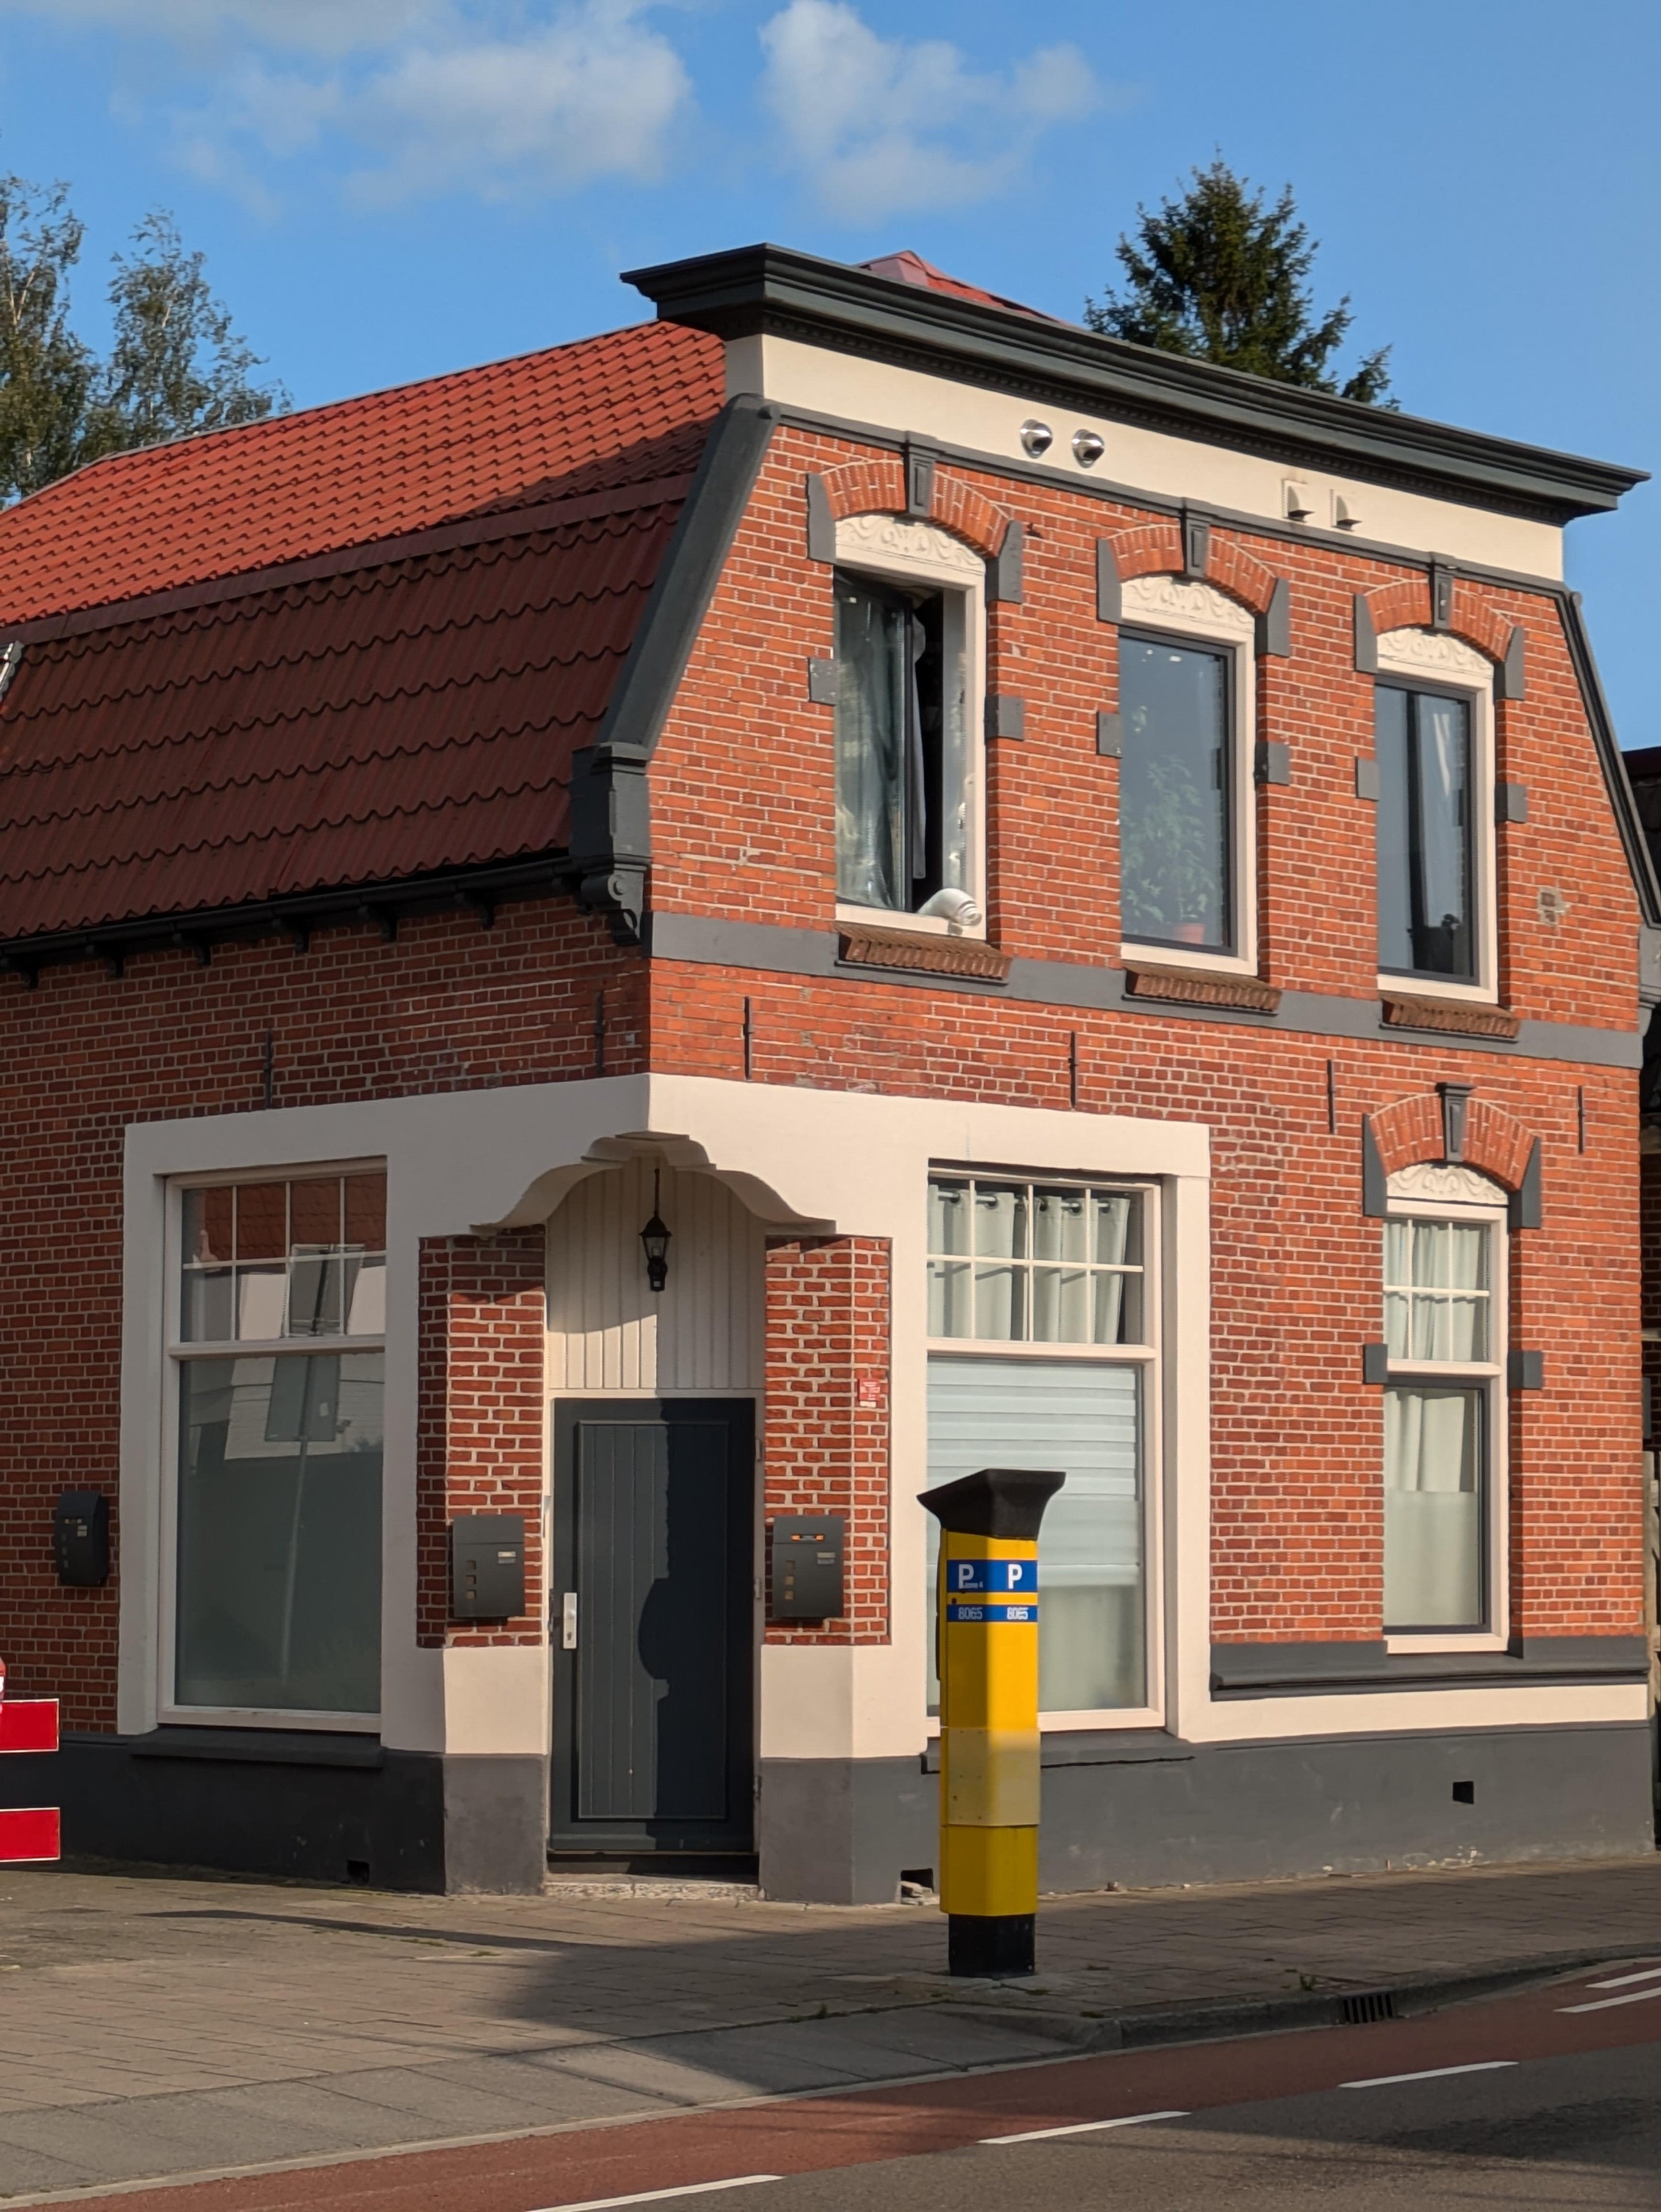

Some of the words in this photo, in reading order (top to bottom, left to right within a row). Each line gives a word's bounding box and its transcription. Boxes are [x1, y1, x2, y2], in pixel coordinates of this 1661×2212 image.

[959, 1563, 974, 1589] P
[1008, 1563, 1023, 1589] P
[958, 1607, 983, 1620] 8065
